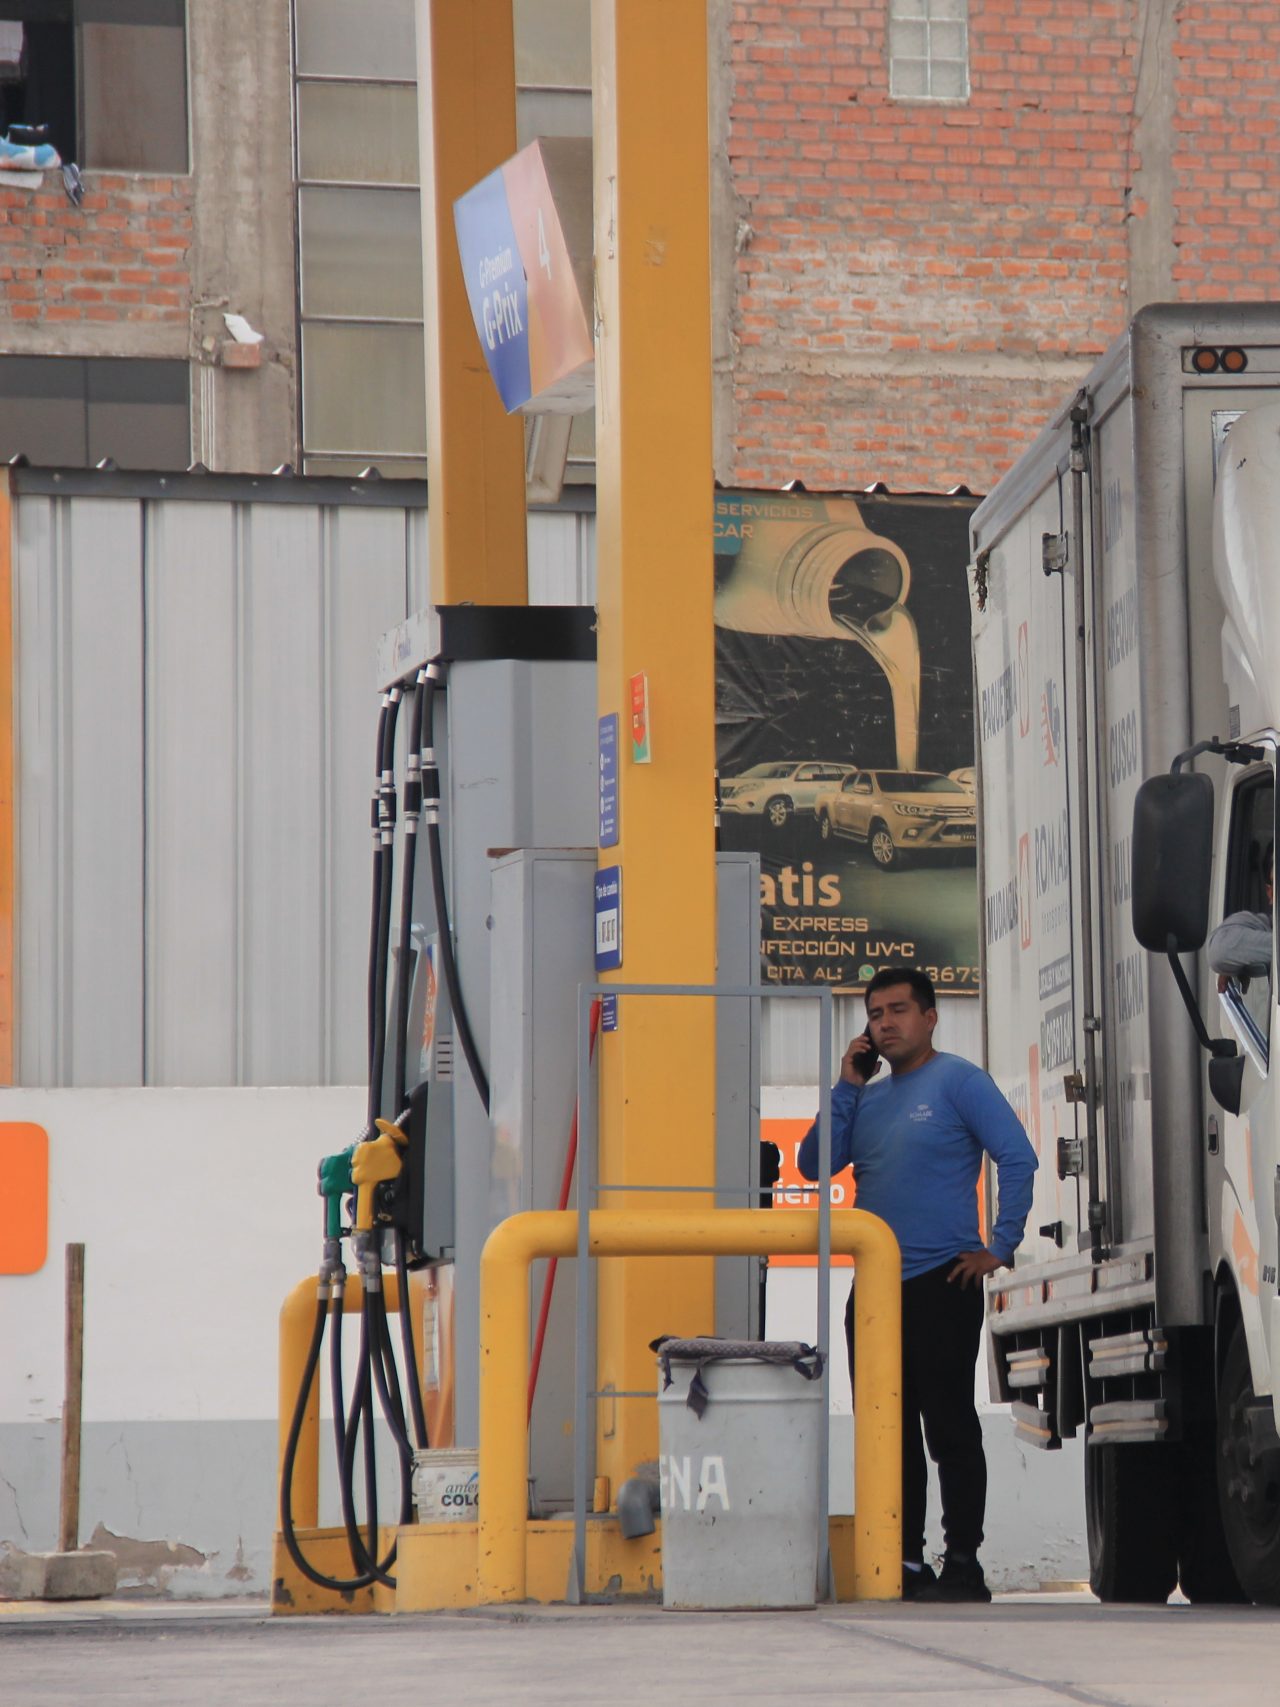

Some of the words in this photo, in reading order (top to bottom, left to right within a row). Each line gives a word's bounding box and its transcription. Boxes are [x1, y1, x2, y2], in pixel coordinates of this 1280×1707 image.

[478, 245, 514, 289] G-Premium
[482, 281, 523, 351] G-Prix
[717, 502, 813, 518] SERVICIOS
[1110, 709, 1137, 789] CUSCO
[760, 861, 842, 907] atis
[1113, 835, 1132, 907] JULI
[760, 934, 855, 956] FECCIÓN
[865, 942, 915, 957] UV-C
[773, 917, 869, 932] EXPRESS
[767, 966, 805, 981] CITA
[814, 966, 843, 981] AL:
[1116, 951, 1144, 1024] TACNA
[772, 1178, 845, 1204] iero
